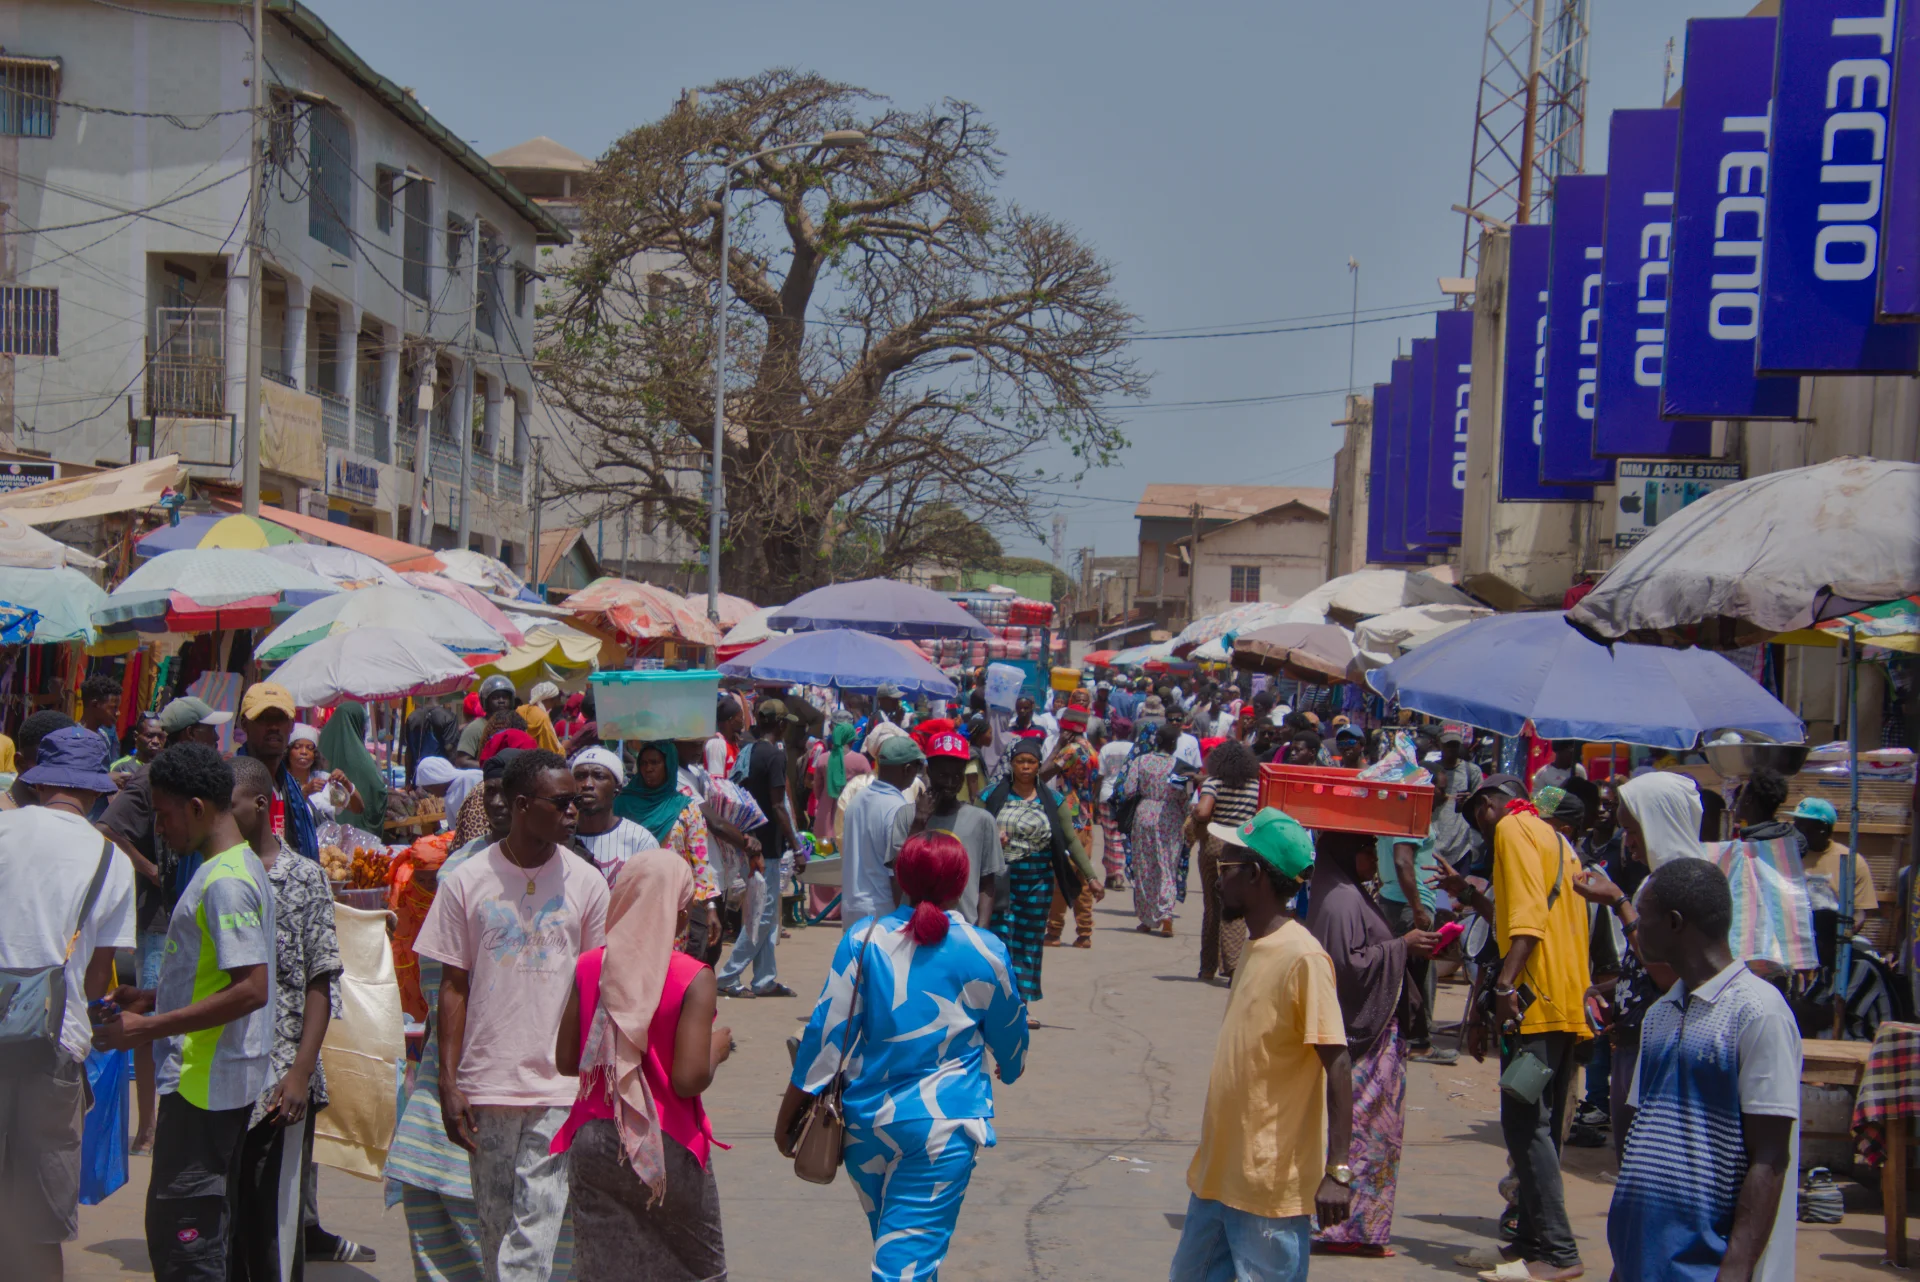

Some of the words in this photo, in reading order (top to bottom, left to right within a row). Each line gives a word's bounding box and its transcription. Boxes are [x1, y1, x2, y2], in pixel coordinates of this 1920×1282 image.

[1708, 98, 1773, 340] TECNO
[1813, 0, 1896, 281] TECNO
[1621, 464, 1650, 476] MMJ
[1653, 464, 1694, 477] APPLE
[1696, 465, 1740, 478] STORE
